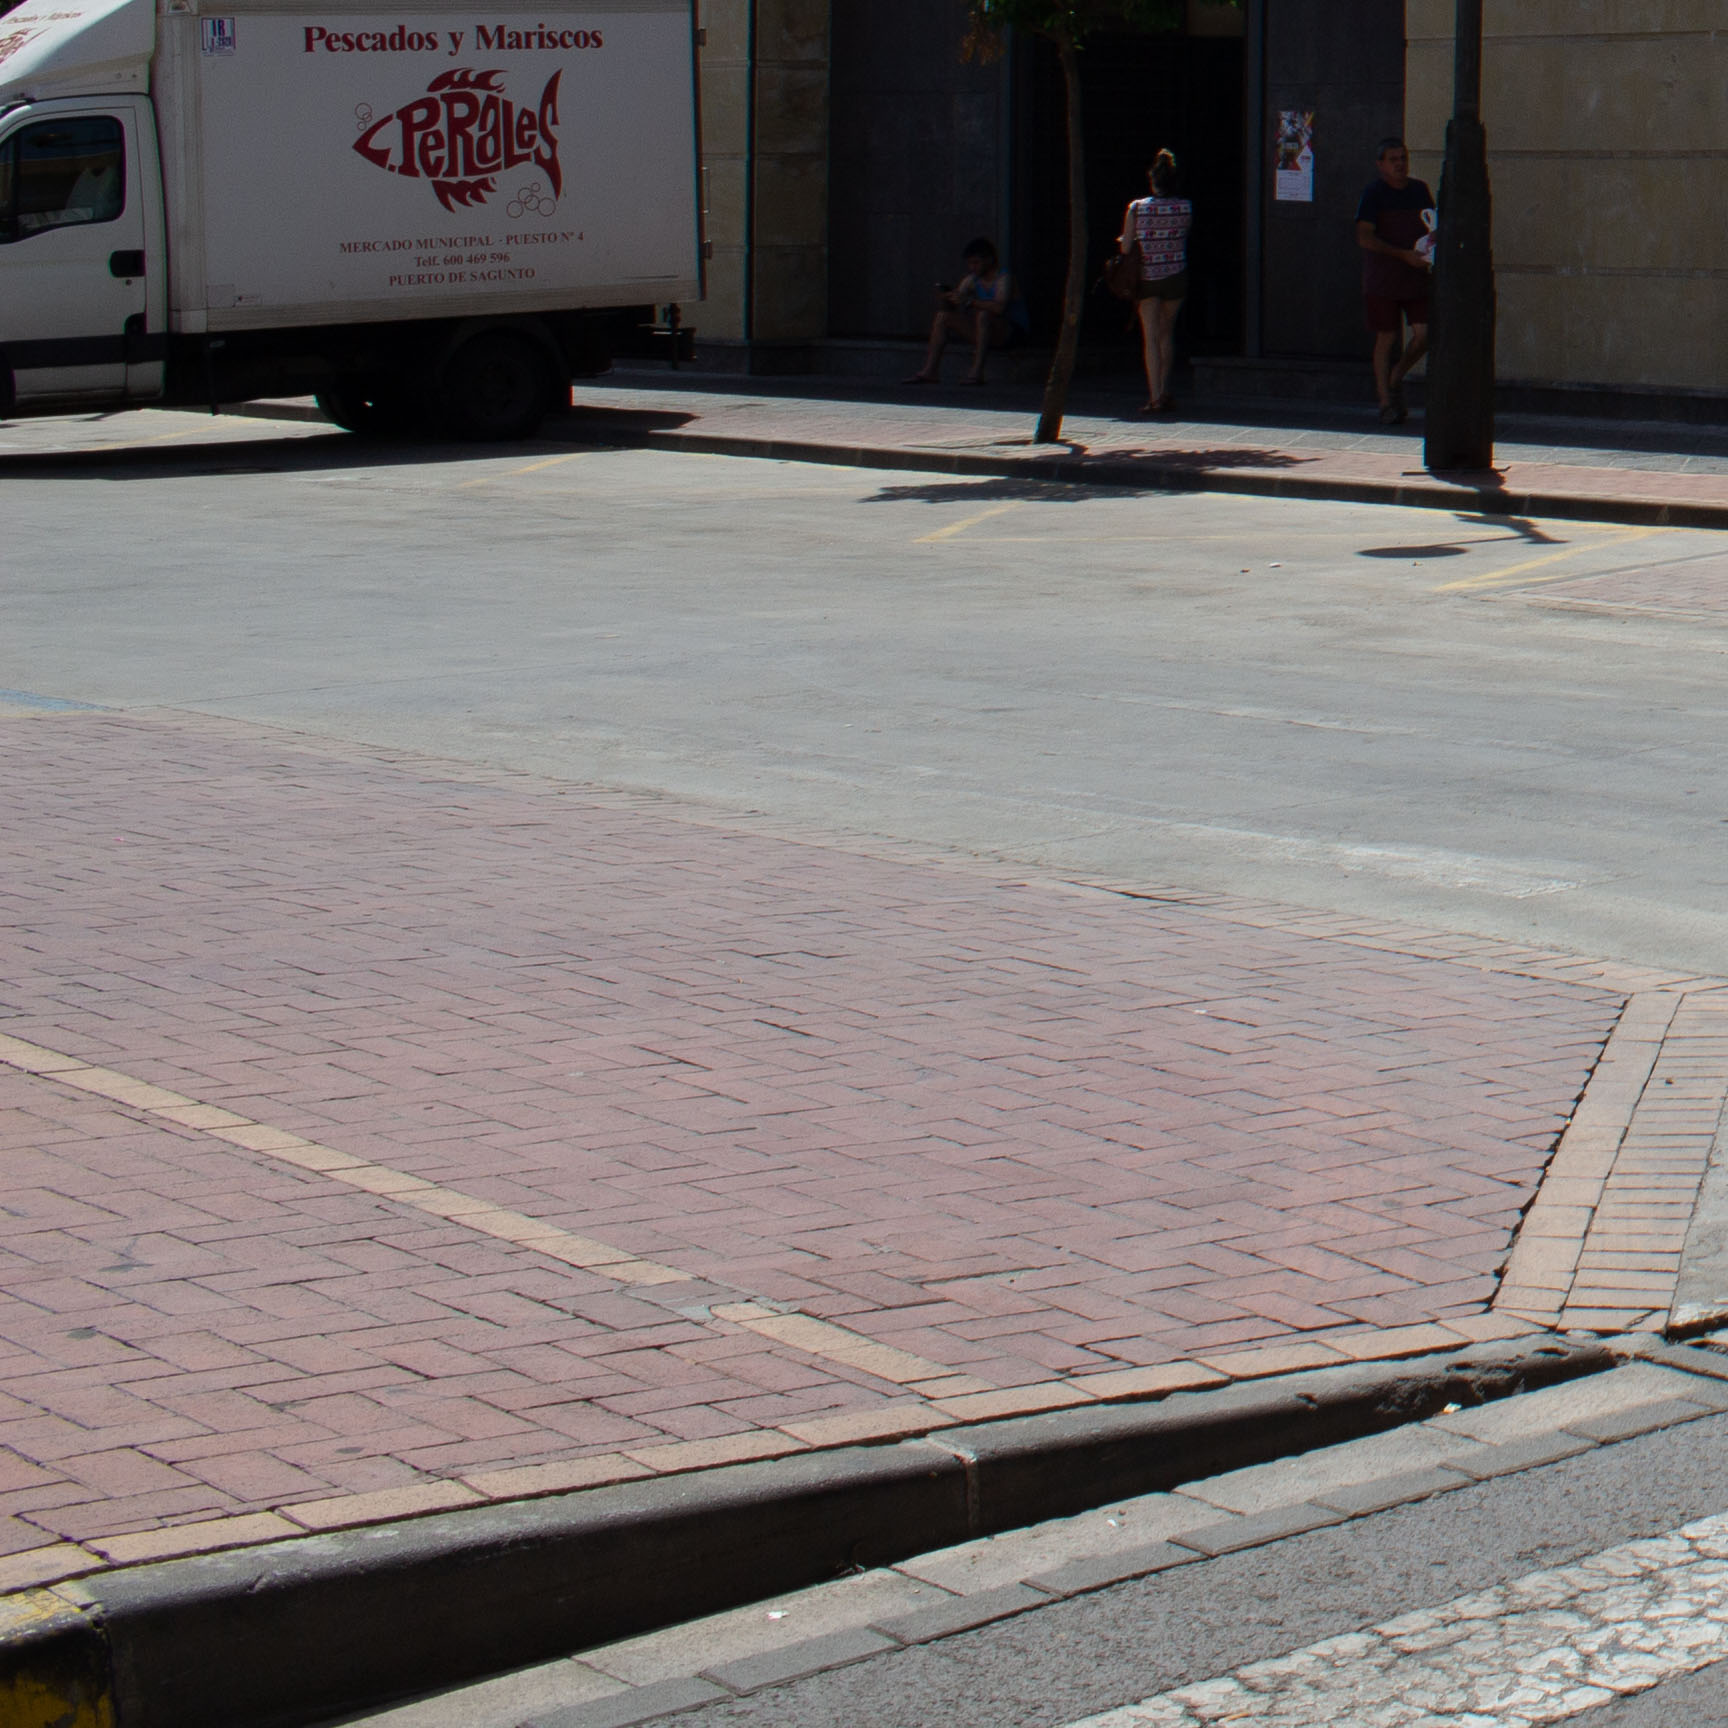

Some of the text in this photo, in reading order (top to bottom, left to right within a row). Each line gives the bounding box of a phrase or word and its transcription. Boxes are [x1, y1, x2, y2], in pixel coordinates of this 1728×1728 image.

[303, 23, 603, 56] Pescados y Mariscos
[339, 239, 412, 253] MERCADO
[415, 235, 494, 250] MUNICIPAL
[505, 232, 558, 246] PUESTO
[576, 232, 584, 242] 4
[415, 252, 511, 267] Telf. 600 469 596
[389, 268, 536, 287] PUERTO DE SAGUNTO
